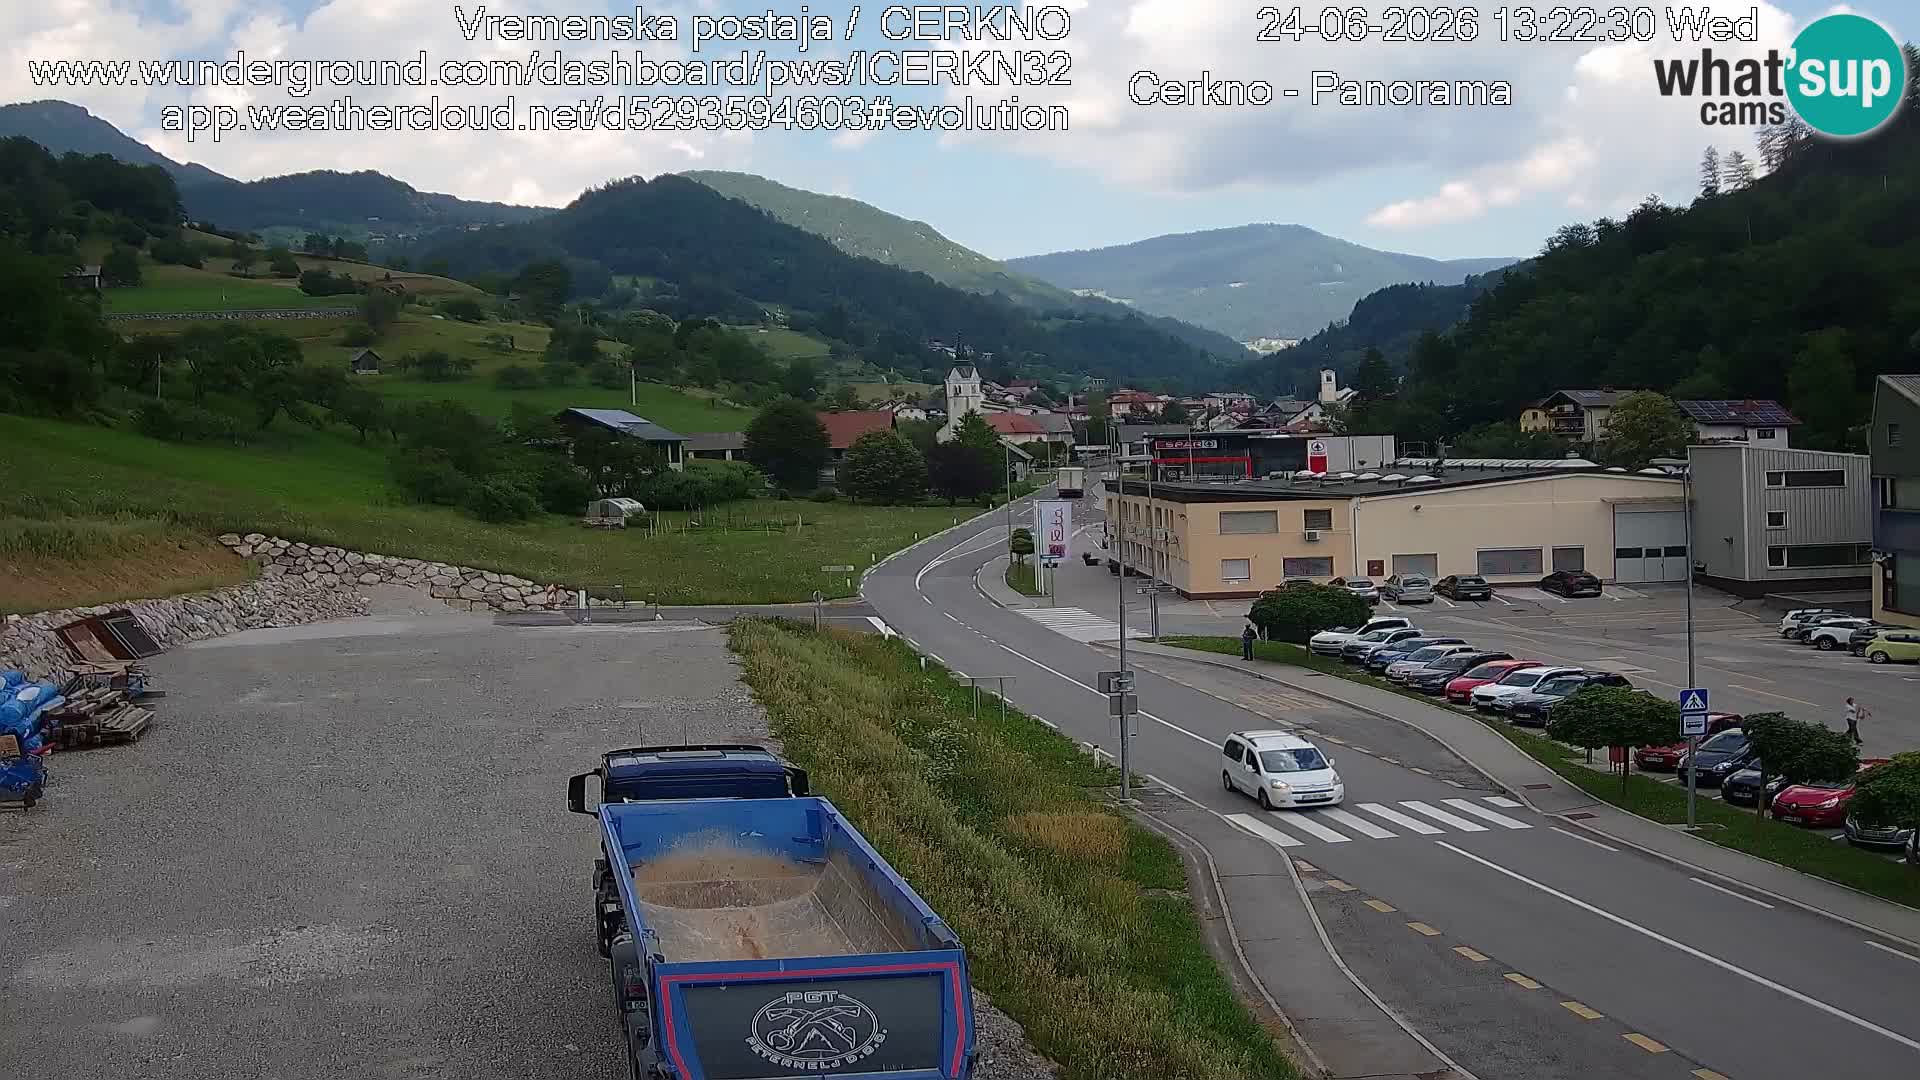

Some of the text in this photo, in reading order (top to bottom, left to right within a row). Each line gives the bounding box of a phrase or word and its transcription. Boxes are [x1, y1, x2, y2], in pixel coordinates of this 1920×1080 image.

[1165, 441, 1201, 449] SPAR
[785, 990, 839, 1005] PGT
[744, 1036, 842, 1071] PETERNELJ
